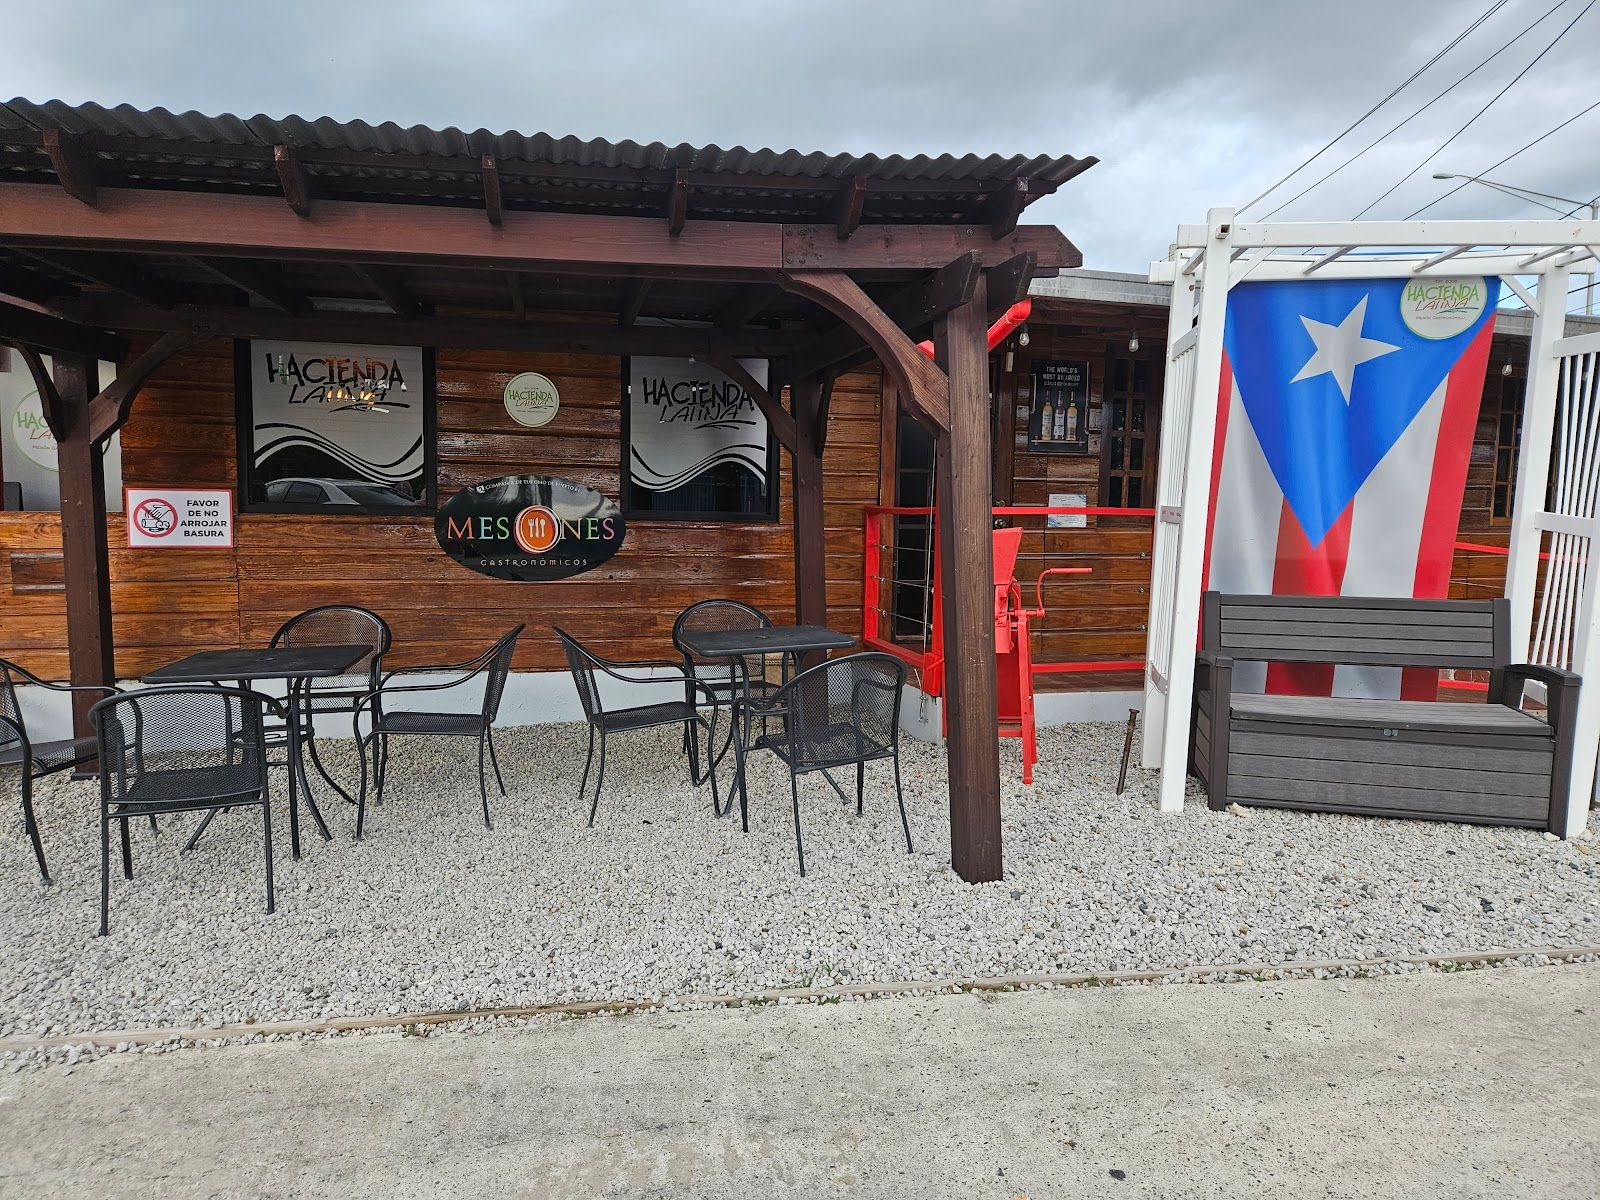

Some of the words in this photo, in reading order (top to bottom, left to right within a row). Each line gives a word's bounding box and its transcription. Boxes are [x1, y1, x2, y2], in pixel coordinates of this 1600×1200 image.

[1407, 284, 1480, 302] HACIENDA
[1415, 297, 1469, 312] LATINA
[265, 352, 408, 392] HACIENDA
[289, 383, 387, 404] LATINA
[508, 389, 554, 403] HACIENDA
[642, 376, 755, 411] HACIENDA
[660, 403, 738, 423] LATINA
